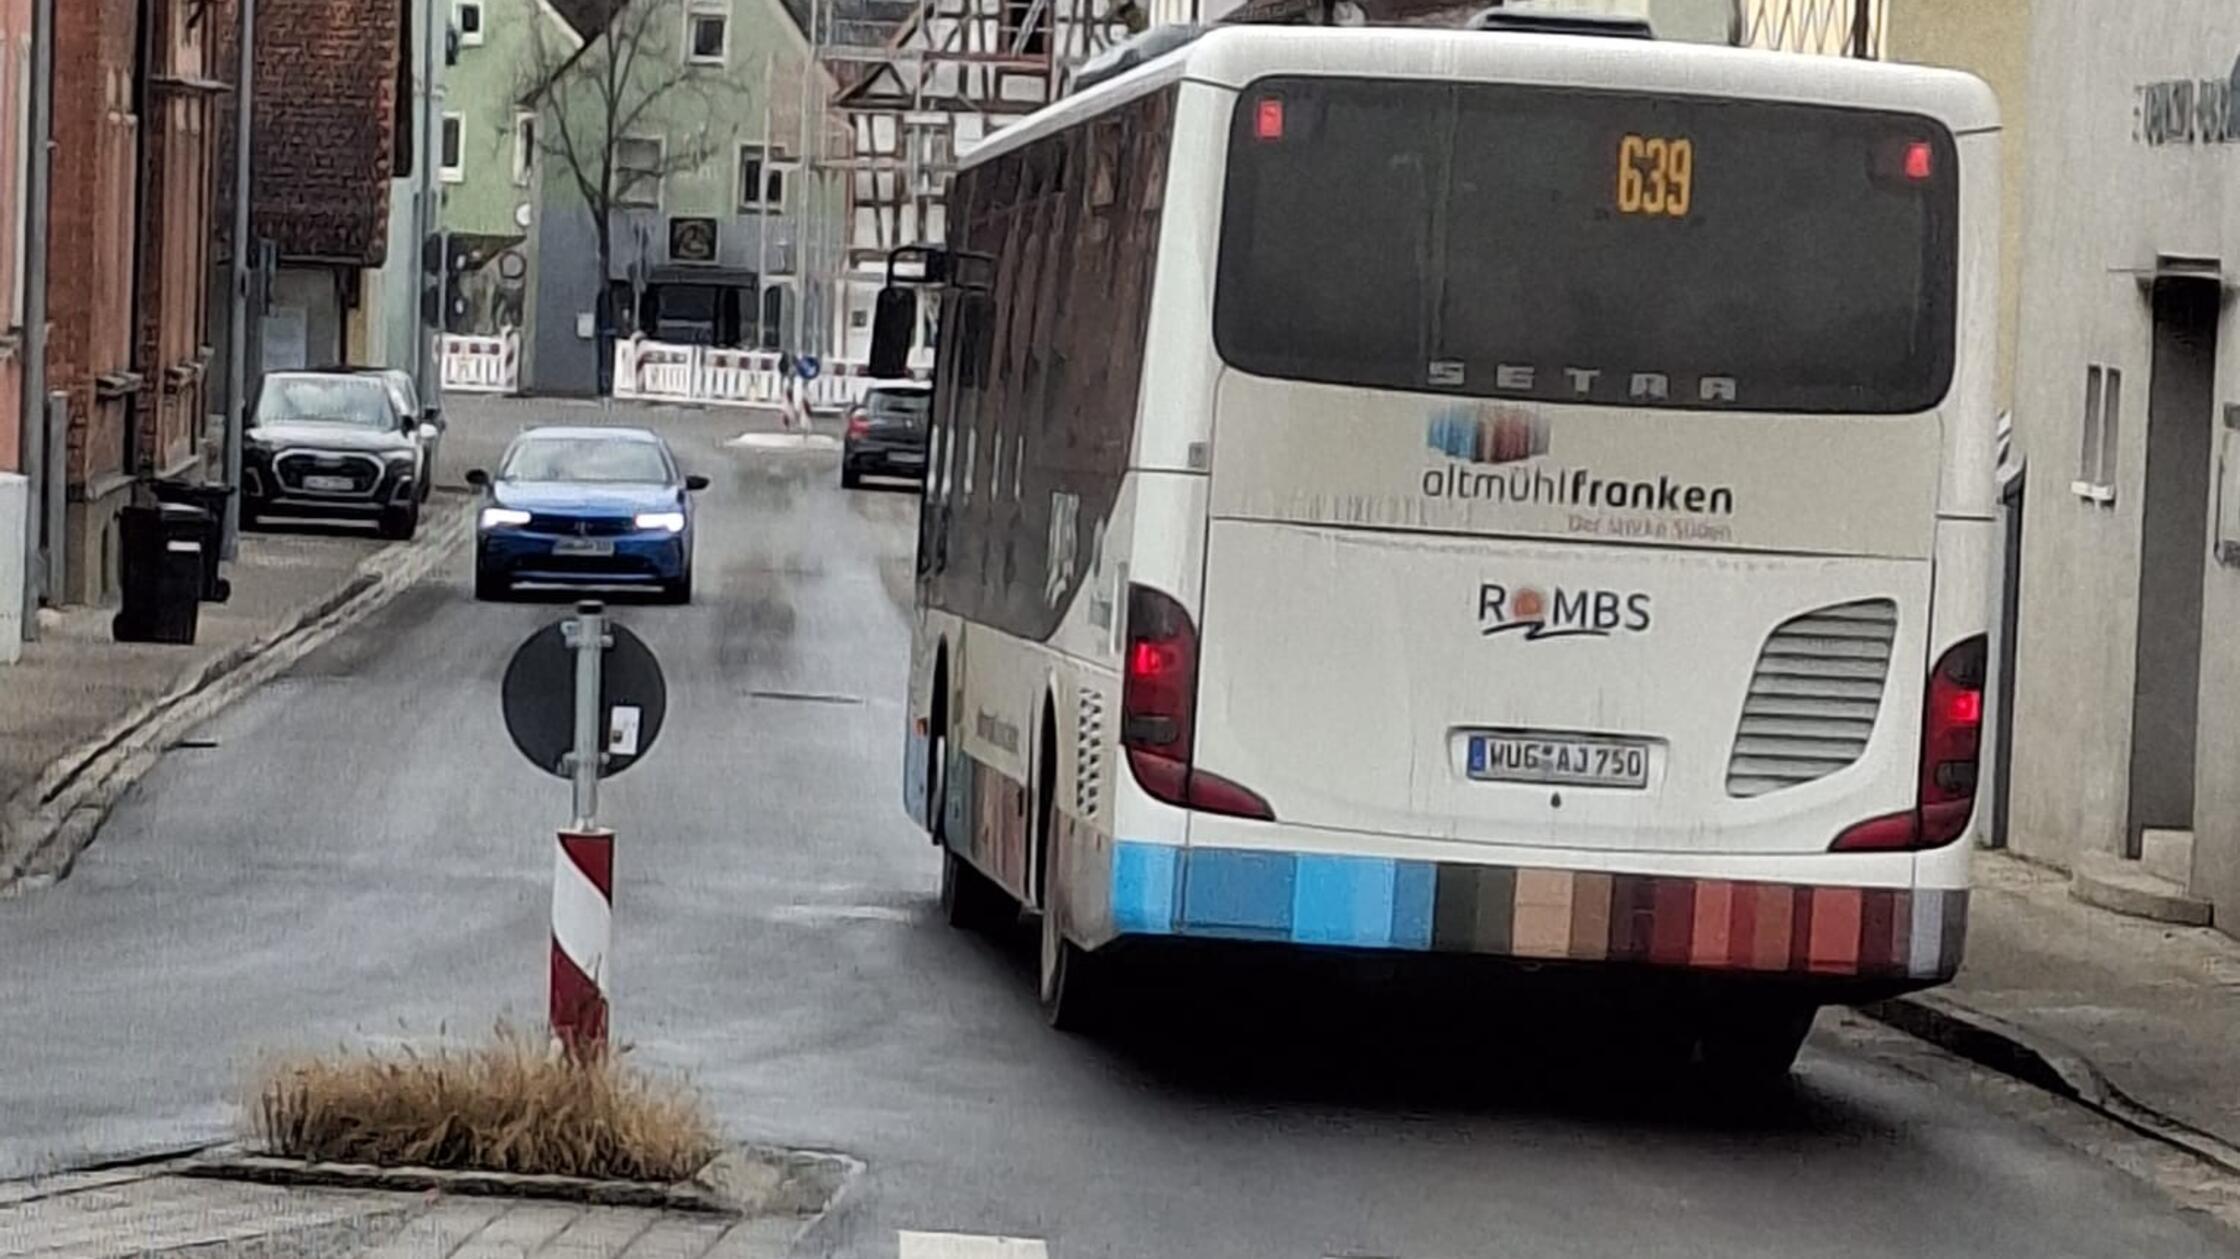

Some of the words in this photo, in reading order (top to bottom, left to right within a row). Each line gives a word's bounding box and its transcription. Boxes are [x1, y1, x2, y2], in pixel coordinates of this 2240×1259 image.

[1619, 135, 1692, 215] 639
[1427, 361, 1737, 400] SETRA
[1422, 463, 1734, 514] altmühlfranken
